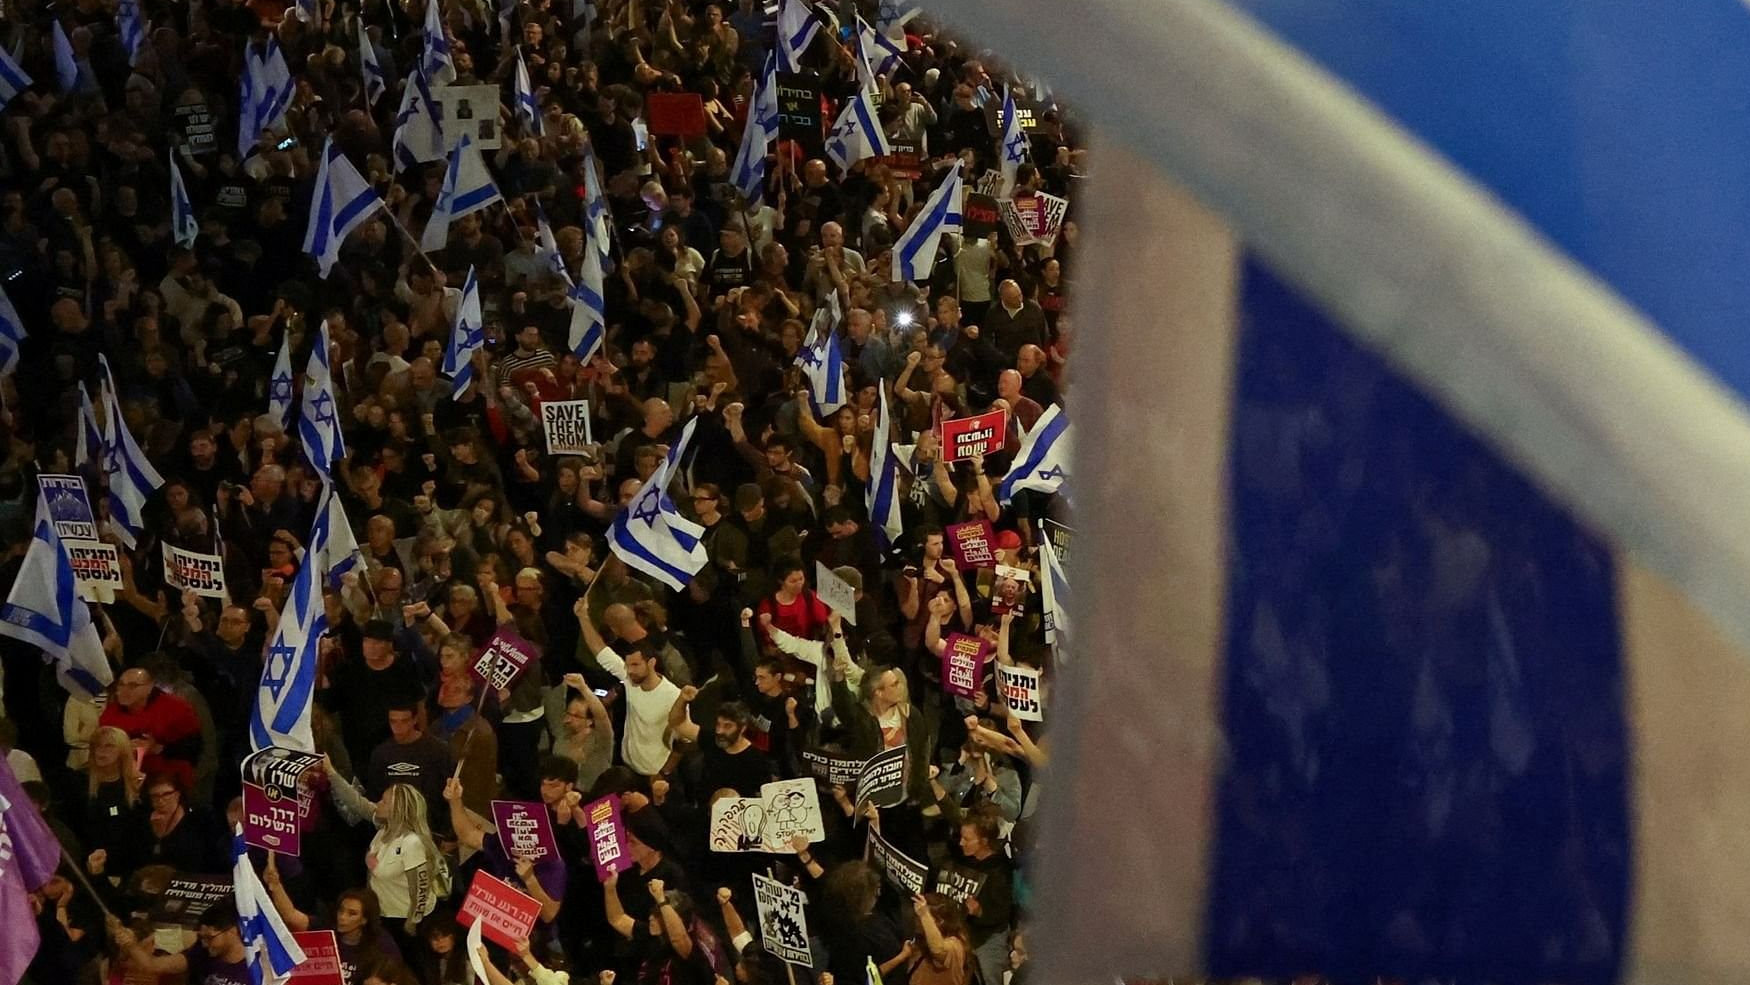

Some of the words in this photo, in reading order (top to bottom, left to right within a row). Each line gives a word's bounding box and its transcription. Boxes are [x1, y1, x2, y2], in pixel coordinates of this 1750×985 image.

[545, 404, 585, 420] SAVE
[547, 420, 586, 434] THEM
[549, 432, 587, 447] FROM
[69, 548, 115, 561] נתניהו
[174, 553, 220, 571] נתניהו
[70, 558, 109, 570] המכש
[270, 807, 296, 821] דרך
[249, 814, 296, 834] השלום
[502, 919, 524, 935] חיים
